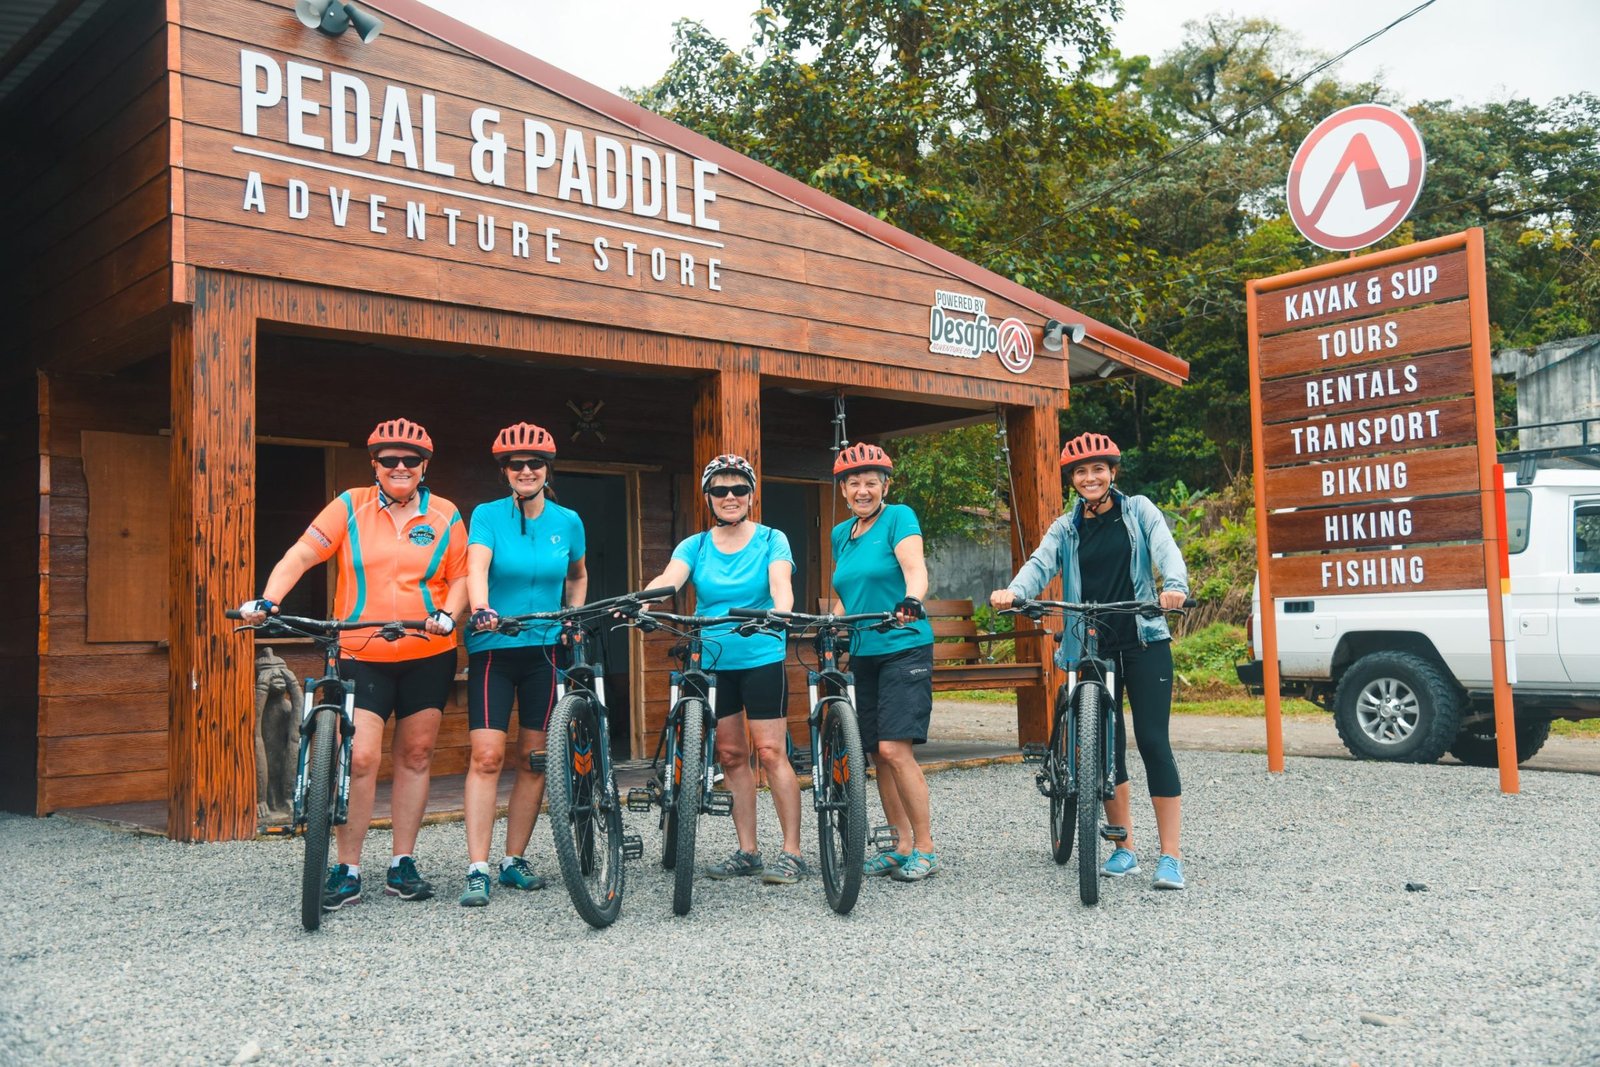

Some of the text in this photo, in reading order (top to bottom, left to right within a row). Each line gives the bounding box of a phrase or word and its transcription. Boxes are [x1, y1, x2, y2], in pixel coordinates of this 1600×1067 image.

[240, 48, 721, 231] PEDAL & PADDLE
[243, 171, 722, 291] ADVENTURE STORE
[936, 292, 984, 312] POWERED BY
[1285, 264, 1438, 322] KAYAK & SUP
[931, 308, 997, 356] Desafio
[1317, 320, 1398, 360] TOURS
[1306, 364, 1418, 407] RENTALS
[1290, 410, 1440, 455] TRANSPORT
[1321, 461, 1407, 497] BIKING
[1324, 508, 1412, 542] HIKING
[1321, 556, 1424, 588] FISHING
